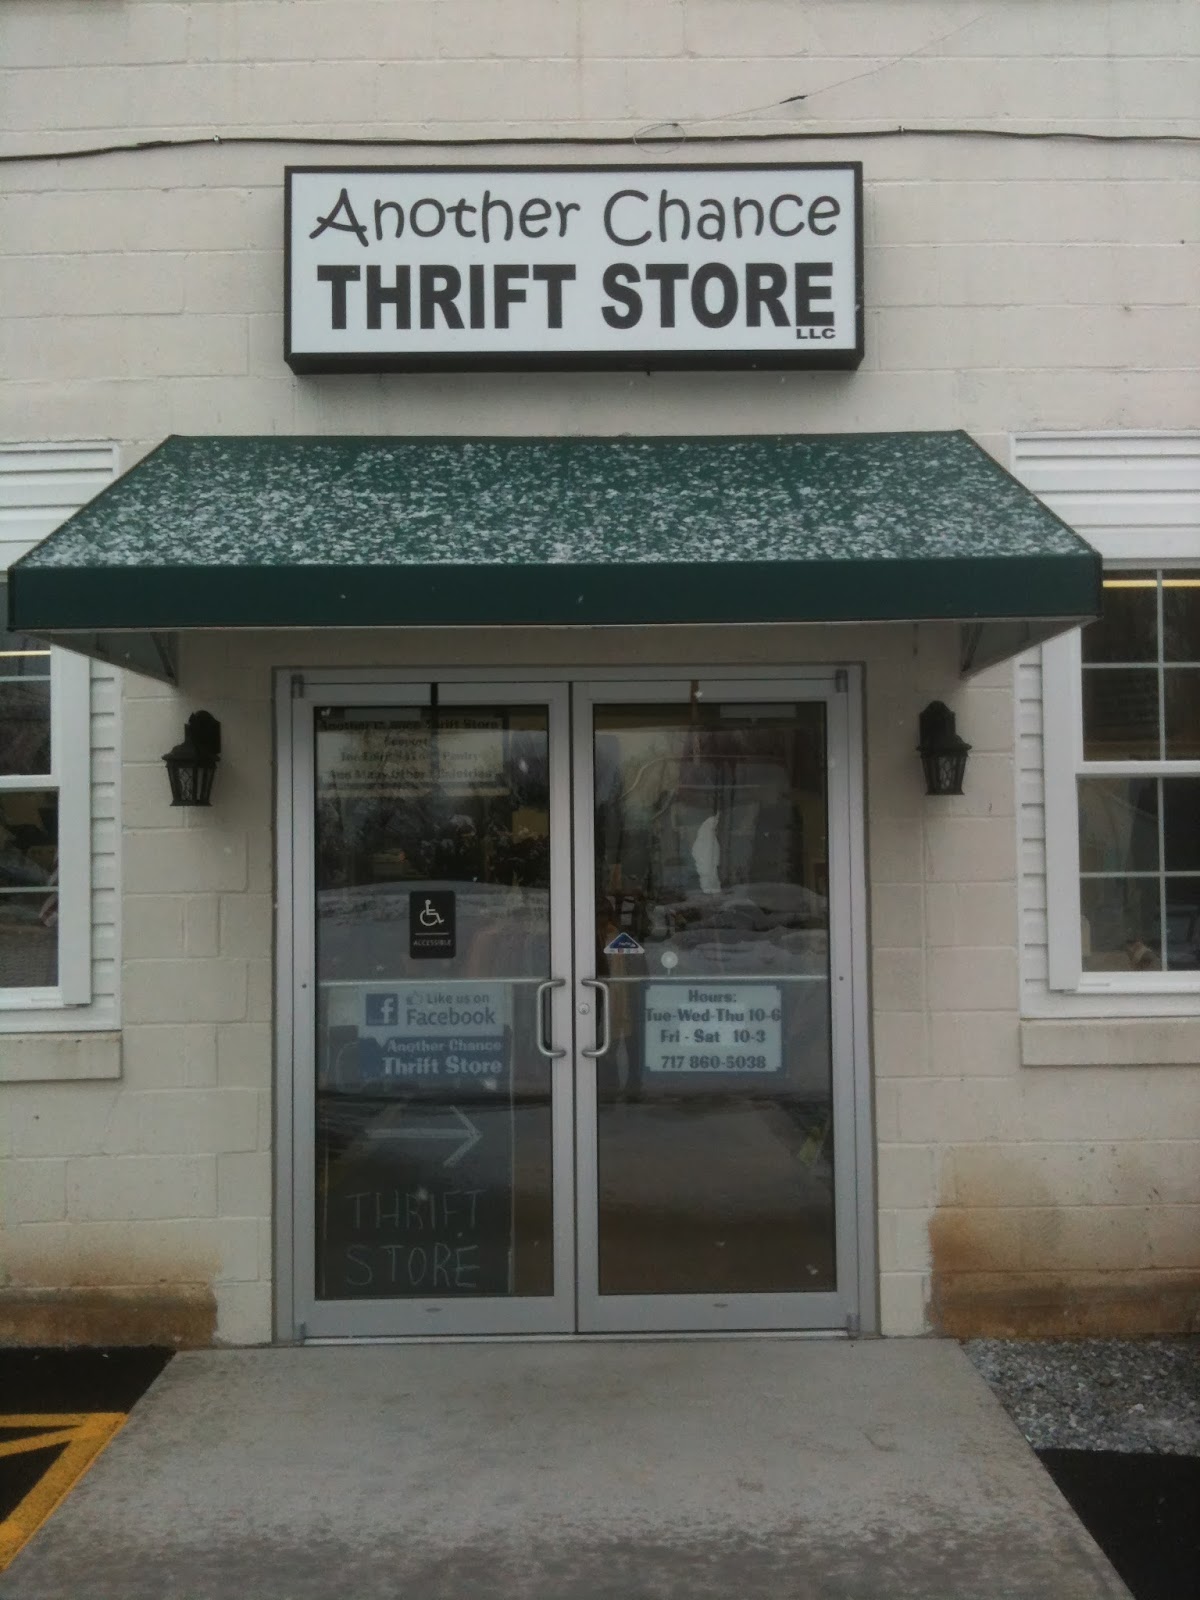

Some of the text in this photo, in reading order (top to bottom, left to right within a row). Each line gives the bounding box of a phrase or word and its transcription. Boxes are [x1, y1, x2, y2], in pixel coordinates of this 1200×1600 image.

[308, 188, 841, 247] Another Chance
[317, 262, 835, 330] THRIFT STORE
[796, 328, 836, 340] LLC
[413, 939, 452, 947] ACCESSIBLE
[427, 993, 489, 1005] Like us on
[688, 989, 737, 1003] Hours:
[406, 1007, 496, 1026] Facebook
[749, 1008, 782, 1022] 10-6
[660, 1029, 680, 1043] Fri
[693, 1029, 721, 1043] Sat
[733, 1029, 766, 1043] 10-3
[387, 1038, 502, 1053] Another Chance
[382, 1055, 503, 1075] Thrift Store
[661, 1055, 766, 1069] 717 860-5038
[346, 1189, 487, 1230] THRIFT
[346, 1242, 481, 1288] STORE
